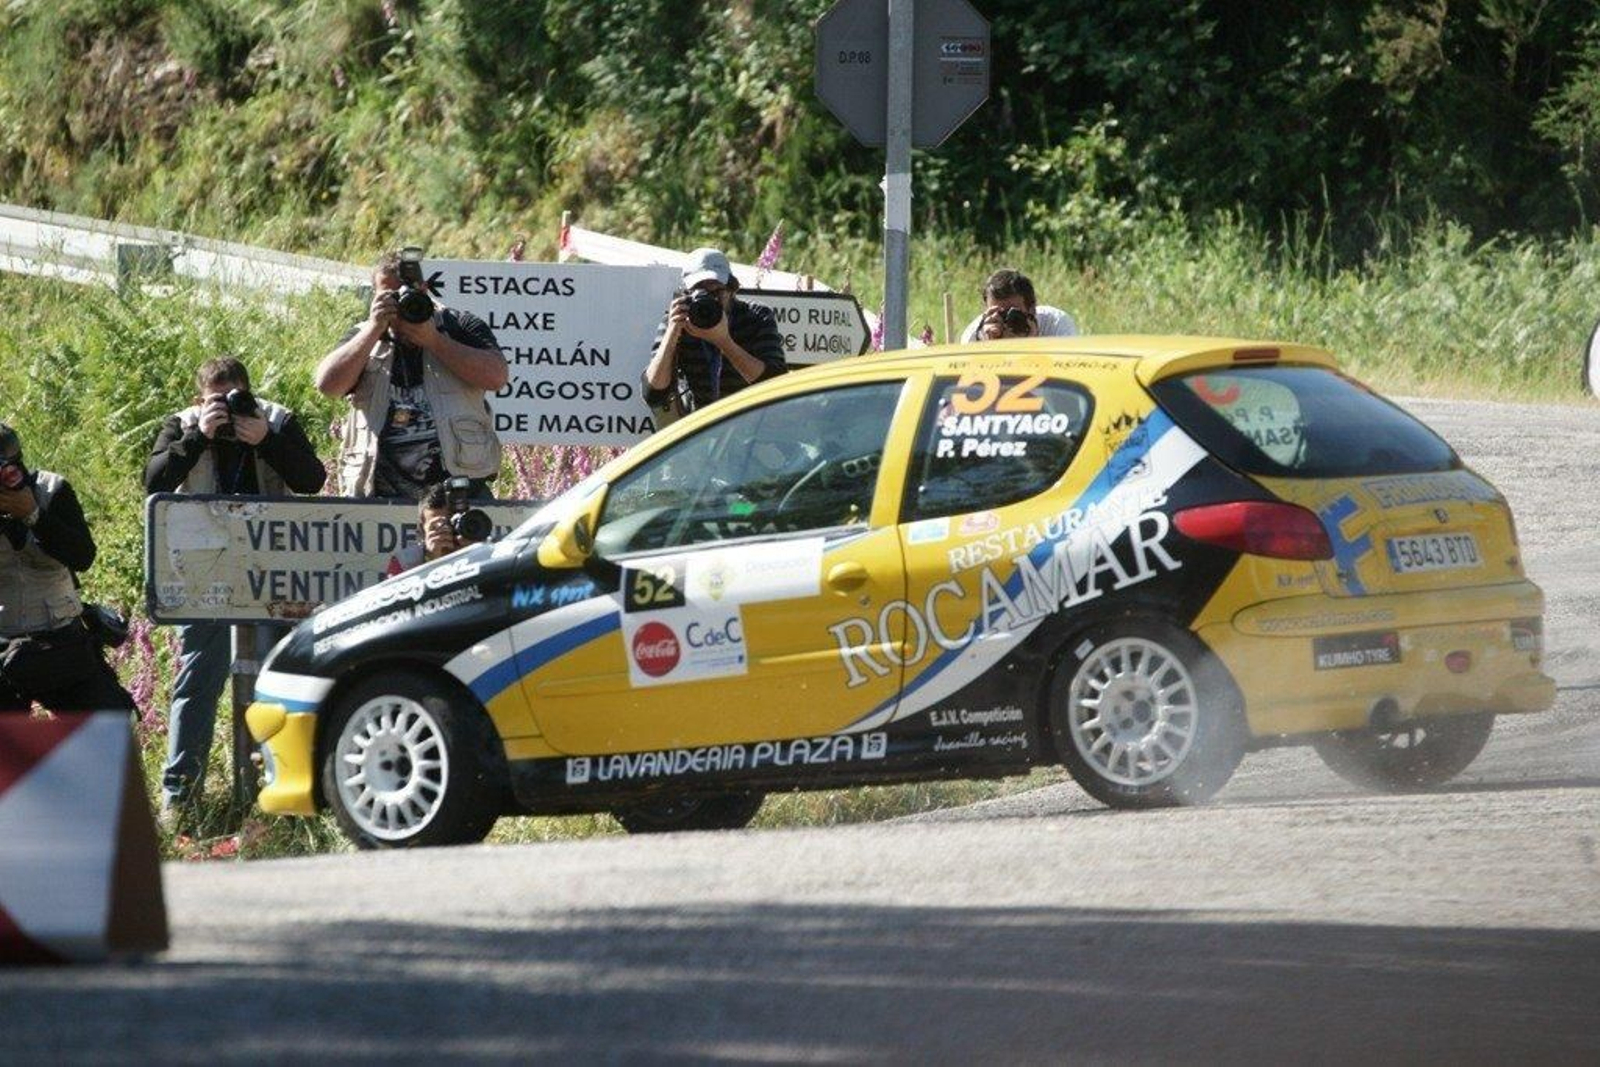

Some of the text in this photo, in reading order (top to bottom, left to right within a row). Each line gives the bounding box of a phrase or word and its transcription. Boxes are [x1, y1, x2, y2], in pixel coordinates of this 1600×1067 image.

[459, 275, 576, 296] ESTACAS
[490, 311, 555, 331] LAXE
[808, 308, 852, 327] RURAL
[500, 340, 610, 366] CHALÁN
[951, 358, 1050, 415] 52
[495, 413, 655, 434] DE MAGINA
[936, 437, 1027, 458] P. Pérez
[246, 513, 364, 553] VENTÍN
[947, 489, 1168, 573] RESTAURANTE
[1399, 536, 1477, 568] 5643 BTD
[247, 563, 364, 601] VENTÍN
[634, 565, 676, 604] 52
[414, 585, 484, 618] INDUSTRIAL
[827, 510, 1182, 688] ROCAMAR
[1319, 648, 1393, 667] KUMHO TYRE
[597, 735, 854, 781] LAVANDERIA PLAZA
